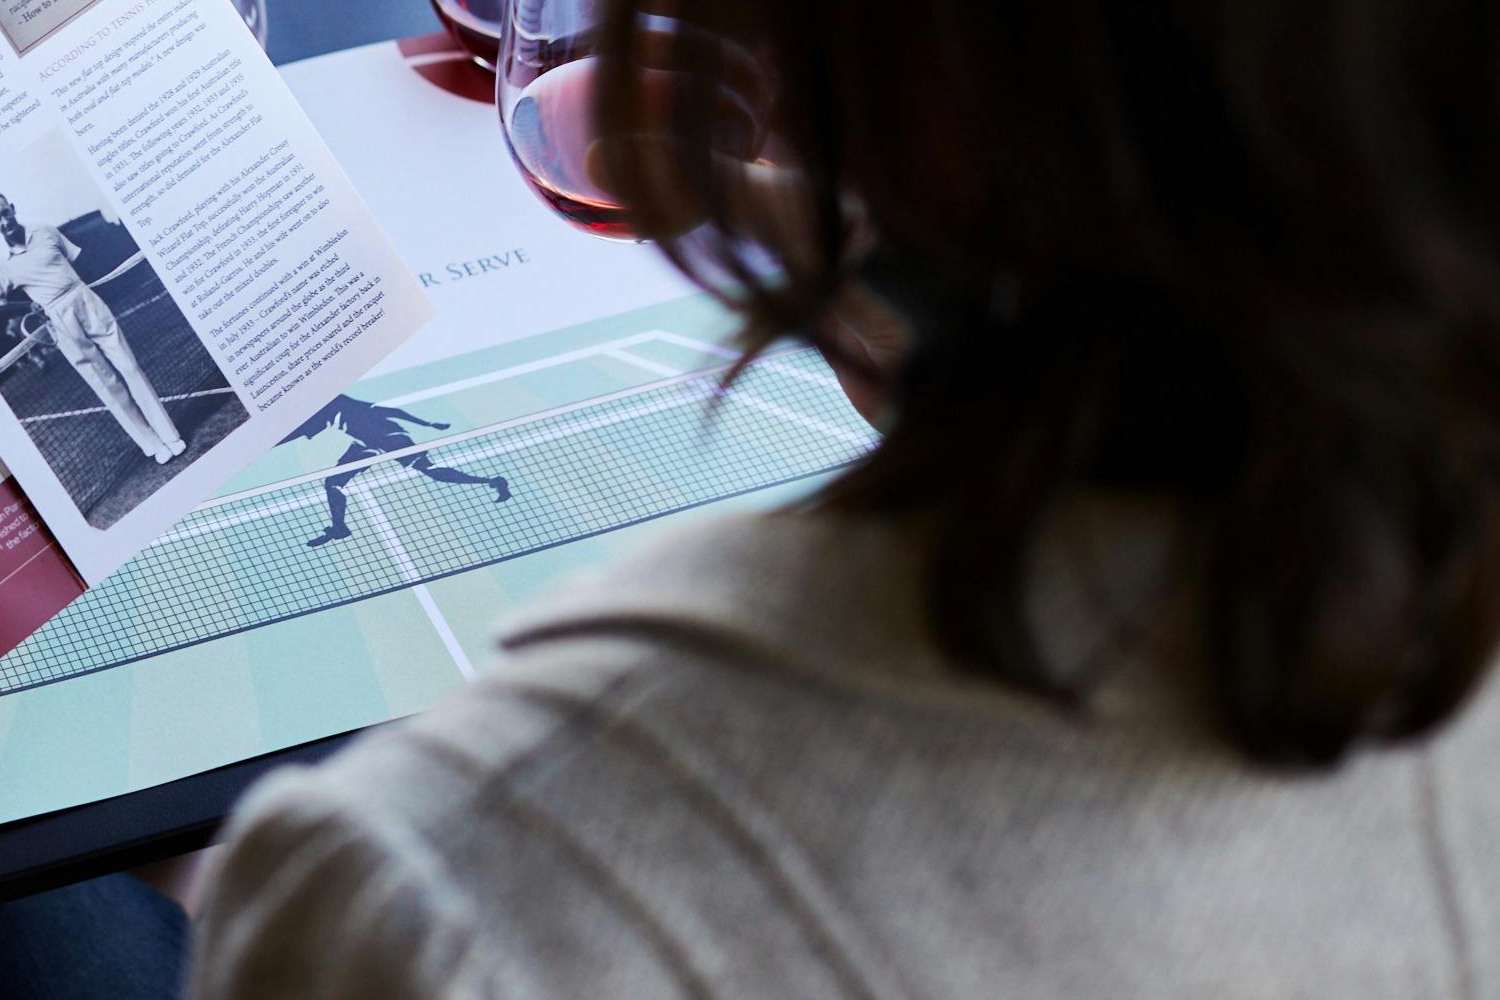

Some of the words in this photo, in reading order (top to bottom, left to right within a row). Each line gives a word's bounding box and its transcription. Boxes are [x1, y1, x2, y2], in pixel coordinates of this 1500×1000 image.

[21, 5, 43, 23] How
[41, 0, 52, 9] to
[445, 247, 532, 281] SERVE
[235, 361, 249, 375] ever
[249, 338, 282, 365] Australian
[279, 332, 288, 340] to
[286, 322, 301, 334] win
[333, 283, 349, 298] This
[347, 274, 360, 286] was
[243, 359, 276, 388] significant
[274, 348, 291, 363] coup
[289, 340, 301, 351] for
[299, 332, 311, 343] the
[310, 308, 341, 335] Alexander
[339, 292, 361, 311] factory
[358, 280, 375, 295] back
[371, 276, 381, 285] in
[257, 391, 283, 412] became
[281, 374, 305, 394] known
[304, 368, 313, 377] as
[310, 360, 323, 371] the
[342, 326, 363, 346] record
[359, 307, 386, 331] breaker!
[287, 355, 305, 372] share
[303, 341, 323, 361] prices
[322, 323, 343, 344] soared
[341, 314, 355, 329] and
[352, 308, 364, 319] the
[362, 291, 385, 311] racquet
